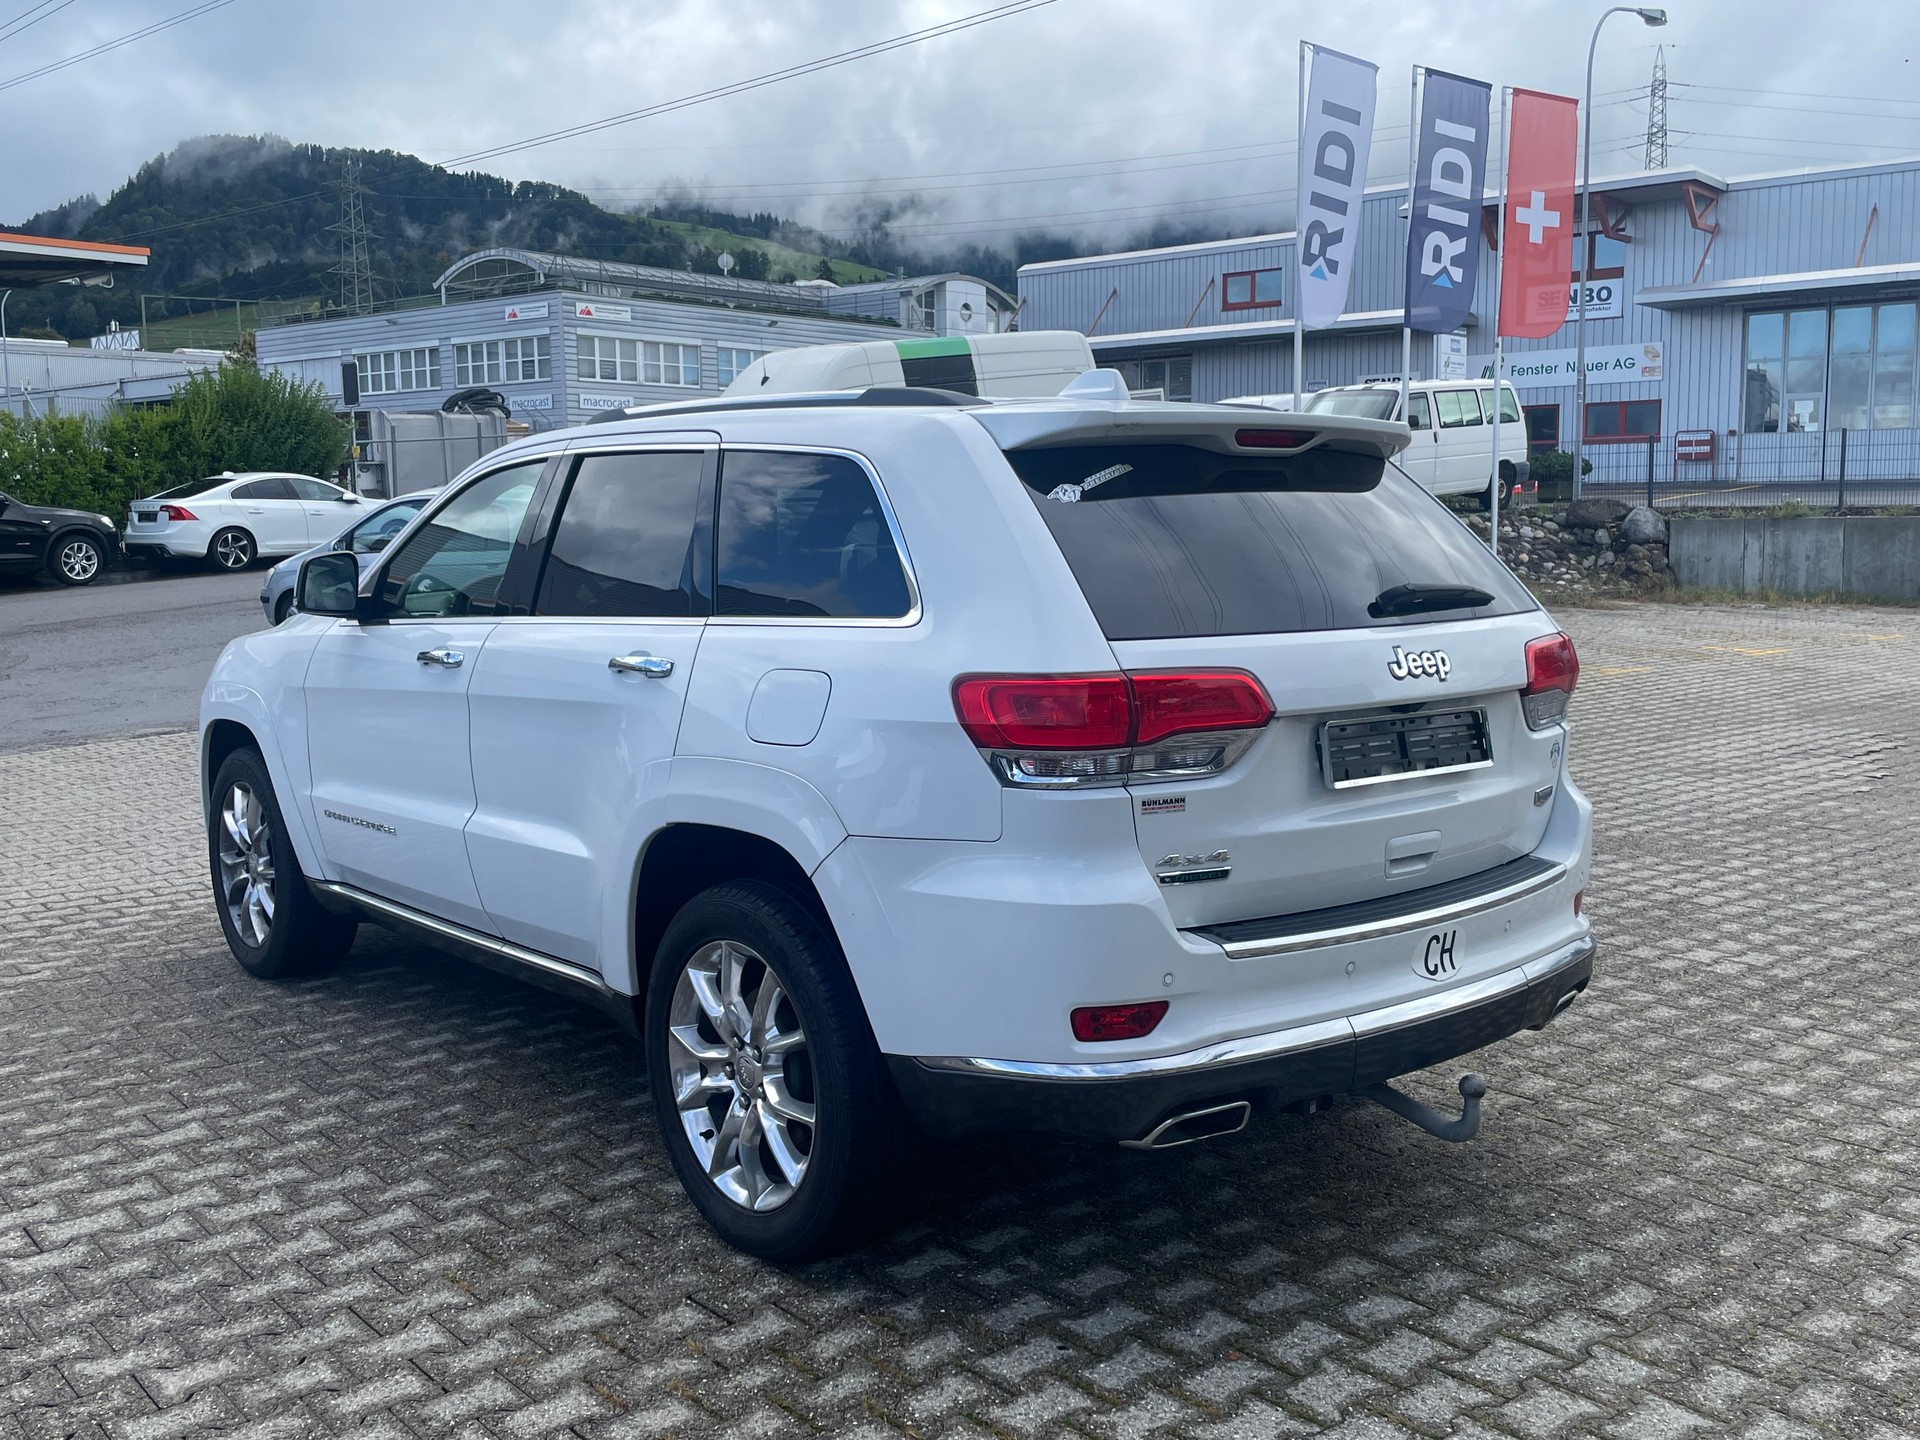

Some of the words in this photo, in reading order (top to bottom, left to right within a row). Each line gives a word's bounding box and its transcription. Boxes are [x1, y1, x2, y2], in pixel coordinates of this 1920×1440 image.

[1301, 98, 1362, 275] RIDI
[1420, 117, 1477, 284] RIDI
[1510, 363, 1559, 377] Fenster
[1566, 360, 1609, 374] Nuer
[1612, 357, 1636, 371] AG
[511, 396, 550, 409] macrocast
[582, 396, 631, 409] macrocast
[1387, 644, 1452, 682] Jeep
[1423, 929, 1457, 977] CH
